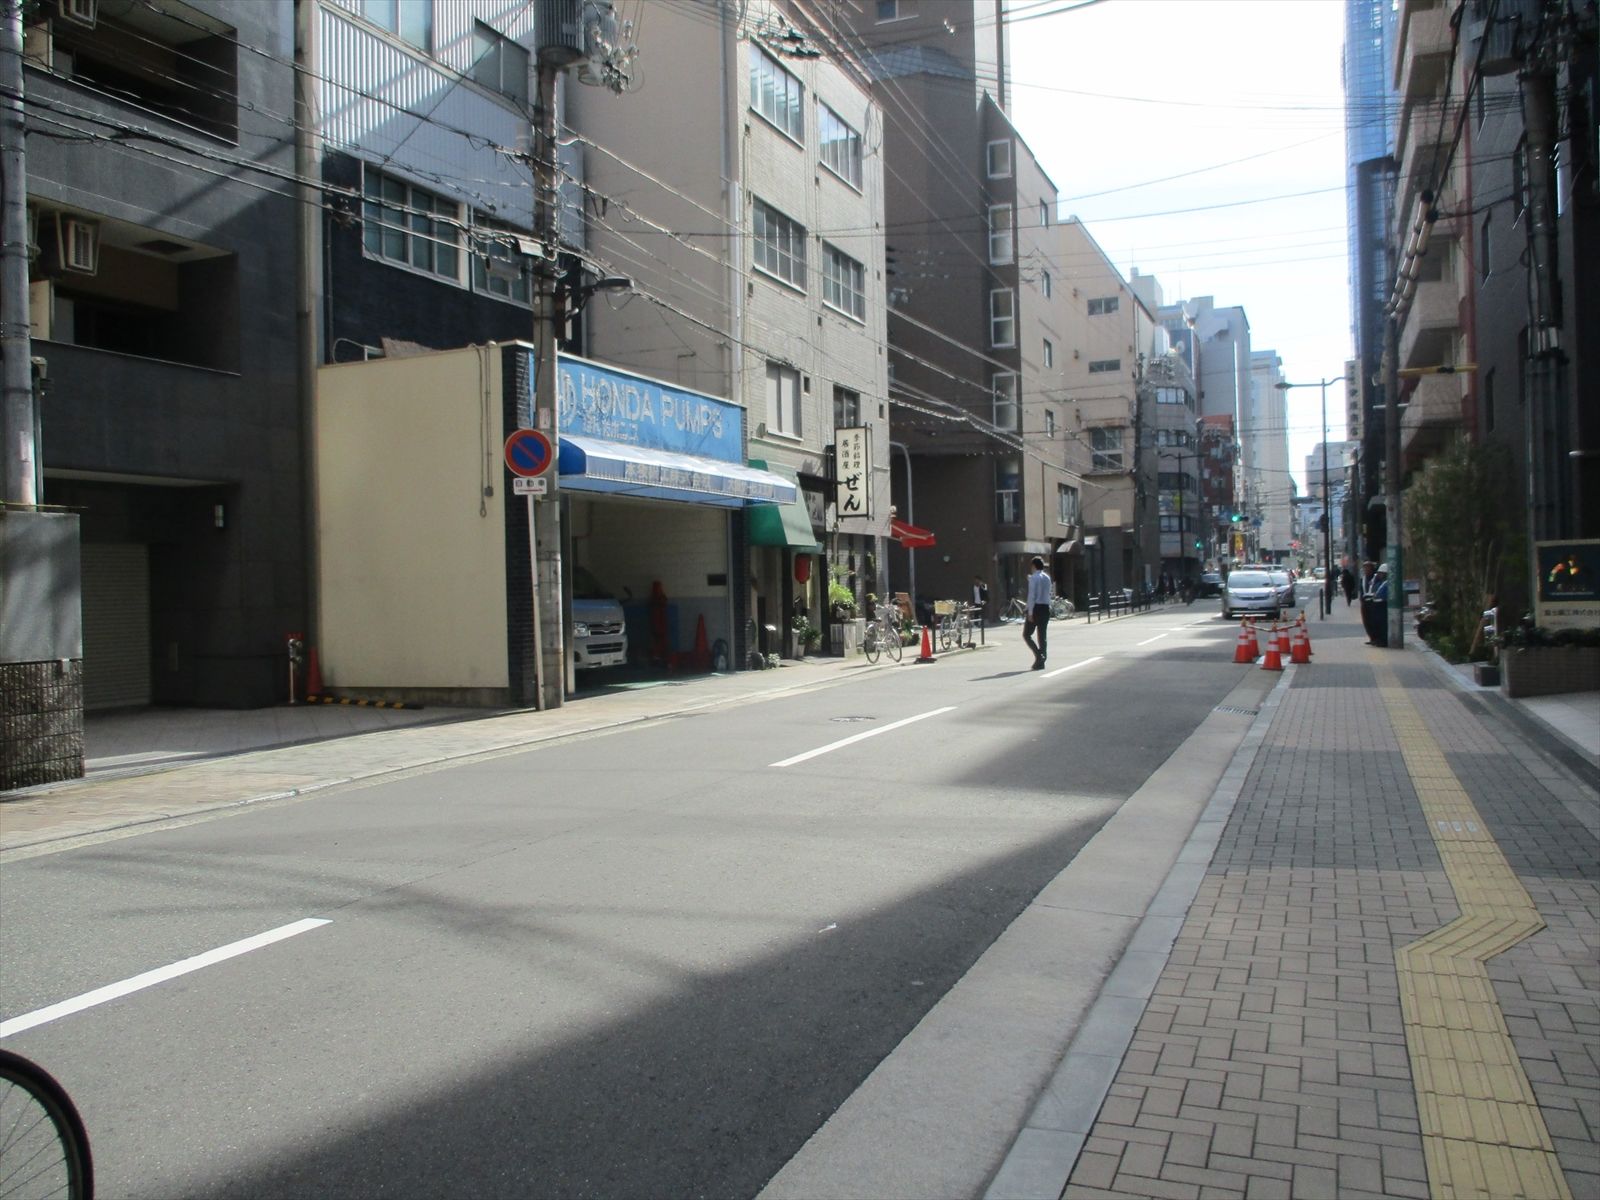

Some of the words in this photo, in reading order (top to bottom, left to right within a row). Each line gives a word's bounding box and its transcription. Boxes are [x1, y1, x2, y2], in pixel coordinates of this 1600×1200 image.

[581, 372, 656, 425] HONDA
[661, 394, 723, 439] PUMPS
[843, 471, 862, 512] ぜん
